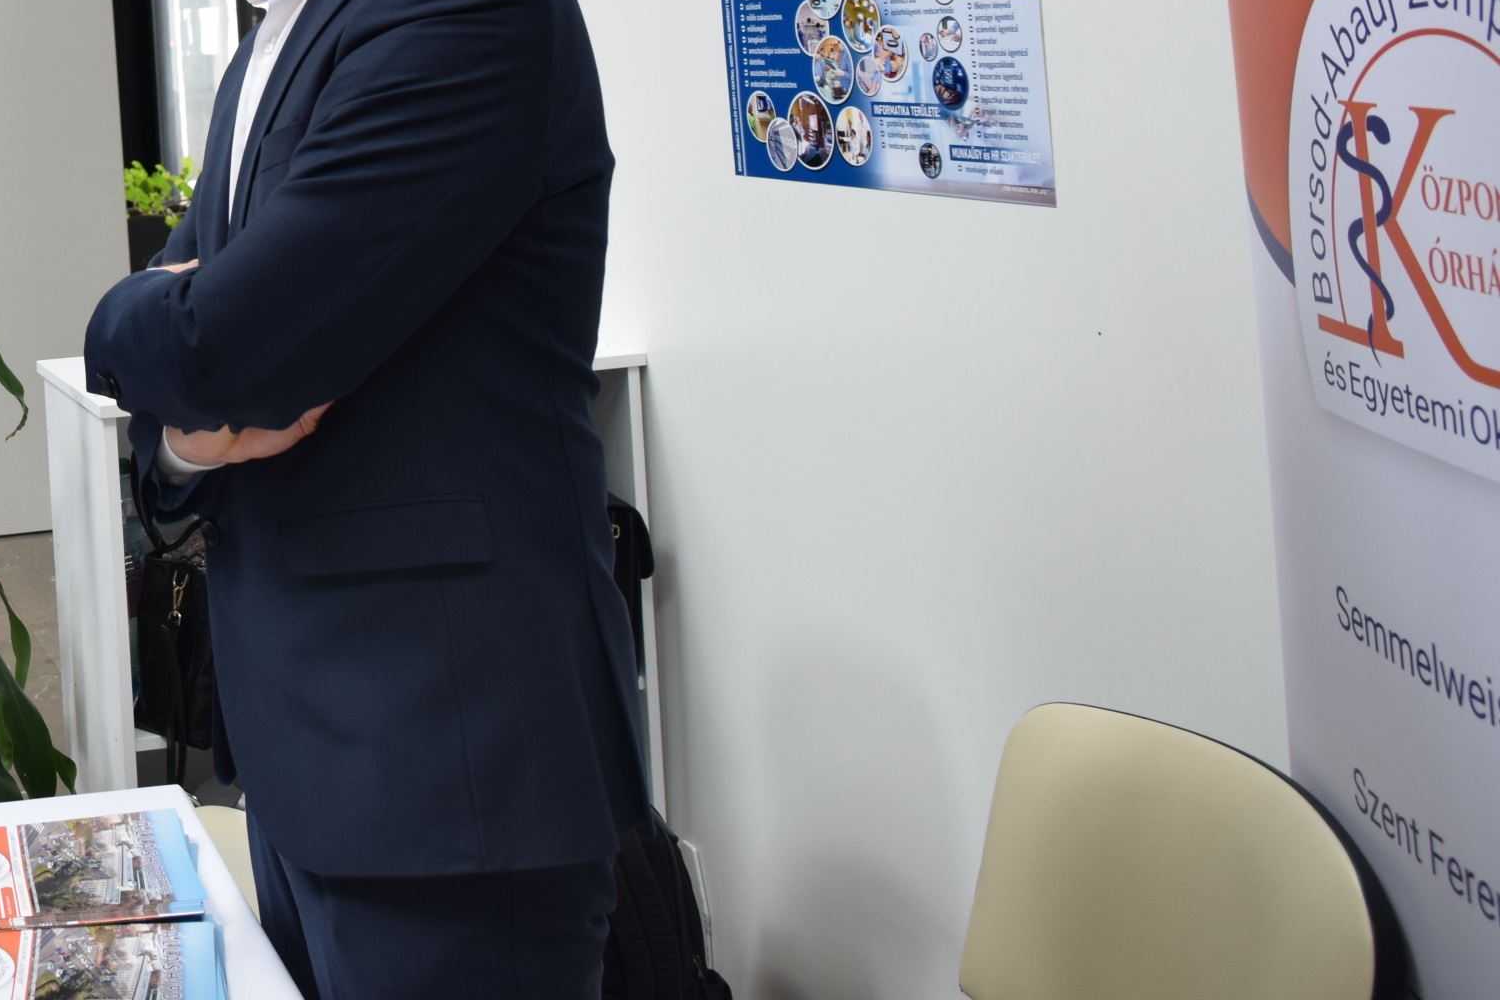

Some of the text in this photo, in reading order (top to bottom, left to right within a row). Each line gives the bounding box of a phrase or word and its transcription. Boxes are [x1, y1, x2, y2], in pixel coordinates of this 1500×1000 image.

[874, 104, 940, 118] INFORMATIKA TERÜLETE:
[952, 146, 982, 160] MUNKAÜGY
[983, 150, 990, 160] és
[991, 150, 1000, 161] HR
[1421, 164, 1500, 222] ÖZPO
[1324, 351, 1346, 392] és
[1348, 360, 1466, 438] Egyetemi
[1336, 585, 1500, 727] Semmelwei
[1353, 768, 1500, 928] Szent Fere
